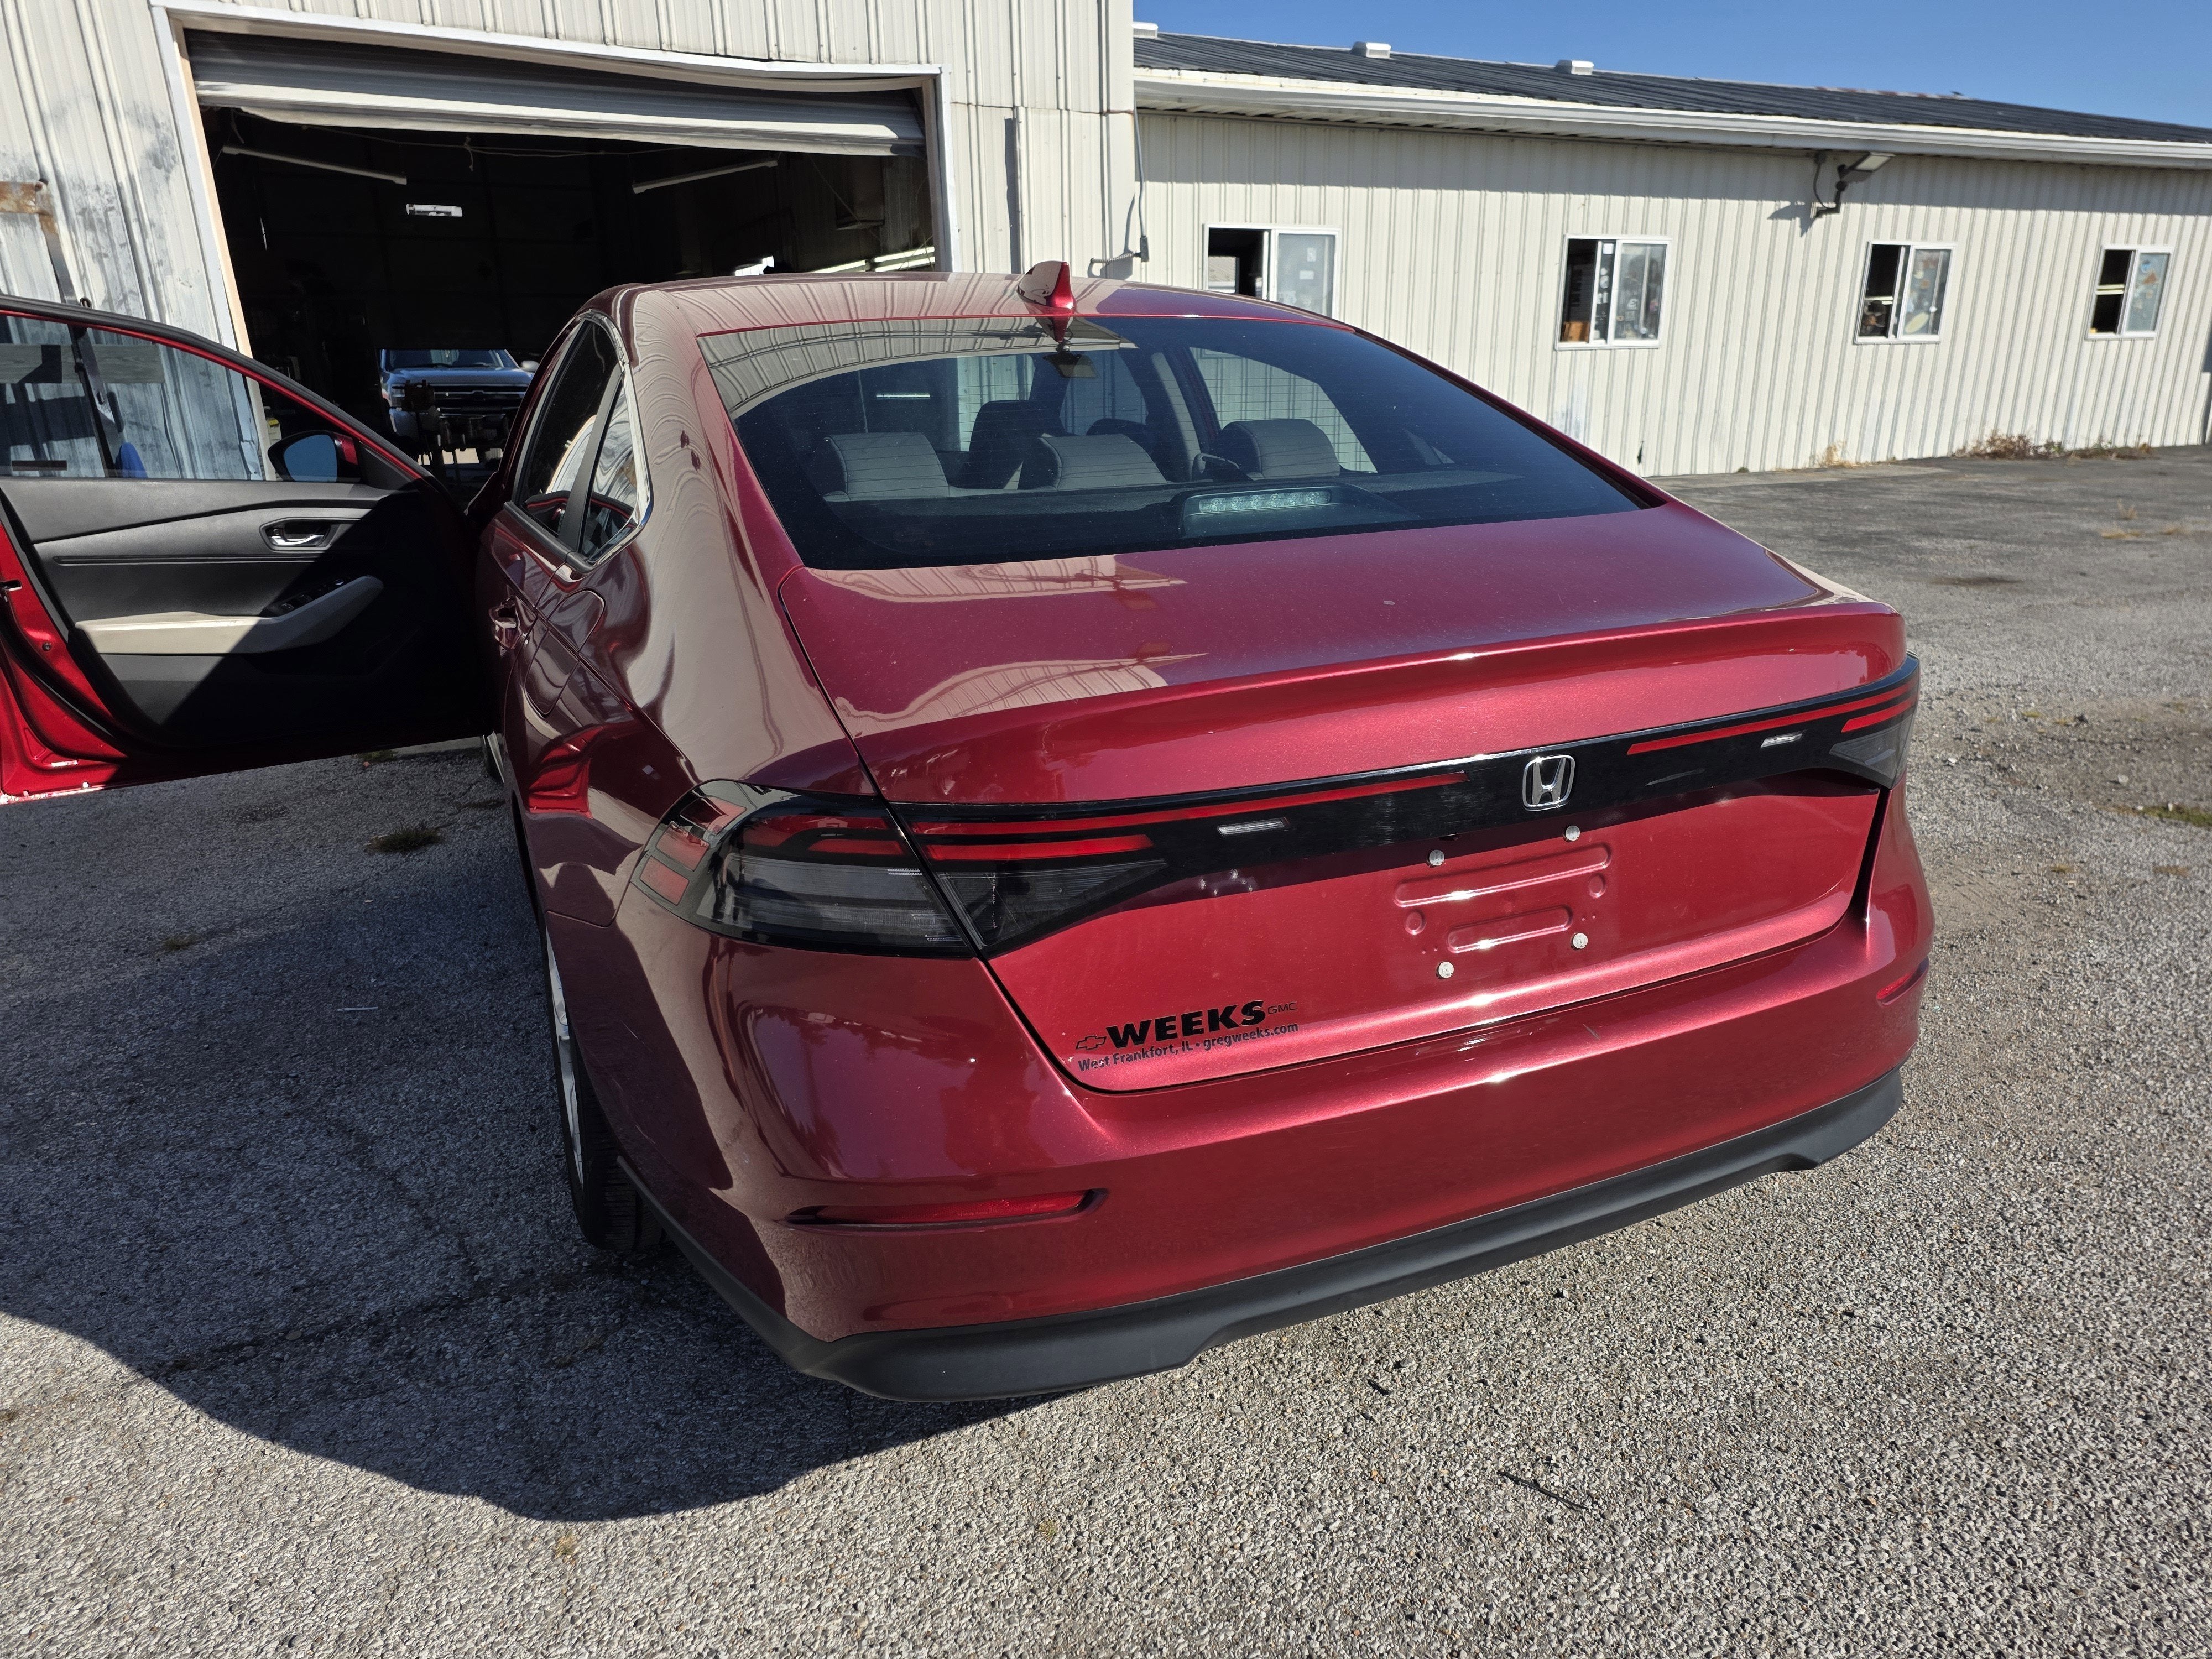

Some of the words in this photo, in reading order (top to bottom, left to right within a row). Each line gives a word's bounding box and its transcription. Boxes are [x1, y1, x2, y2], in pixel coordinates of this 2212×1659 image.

[1078, 1056, 1110, 1071] West
[1113, 1044, 1179, 1065] Frankfort,
[1181, 1040, 1194, 1052] IL
[1203, 1023, 1299, 1051] gregweeks.com
[1106, 1000, 1266, 1049] WEEKS
[1267, 1001, 1298, 1015] GMC
